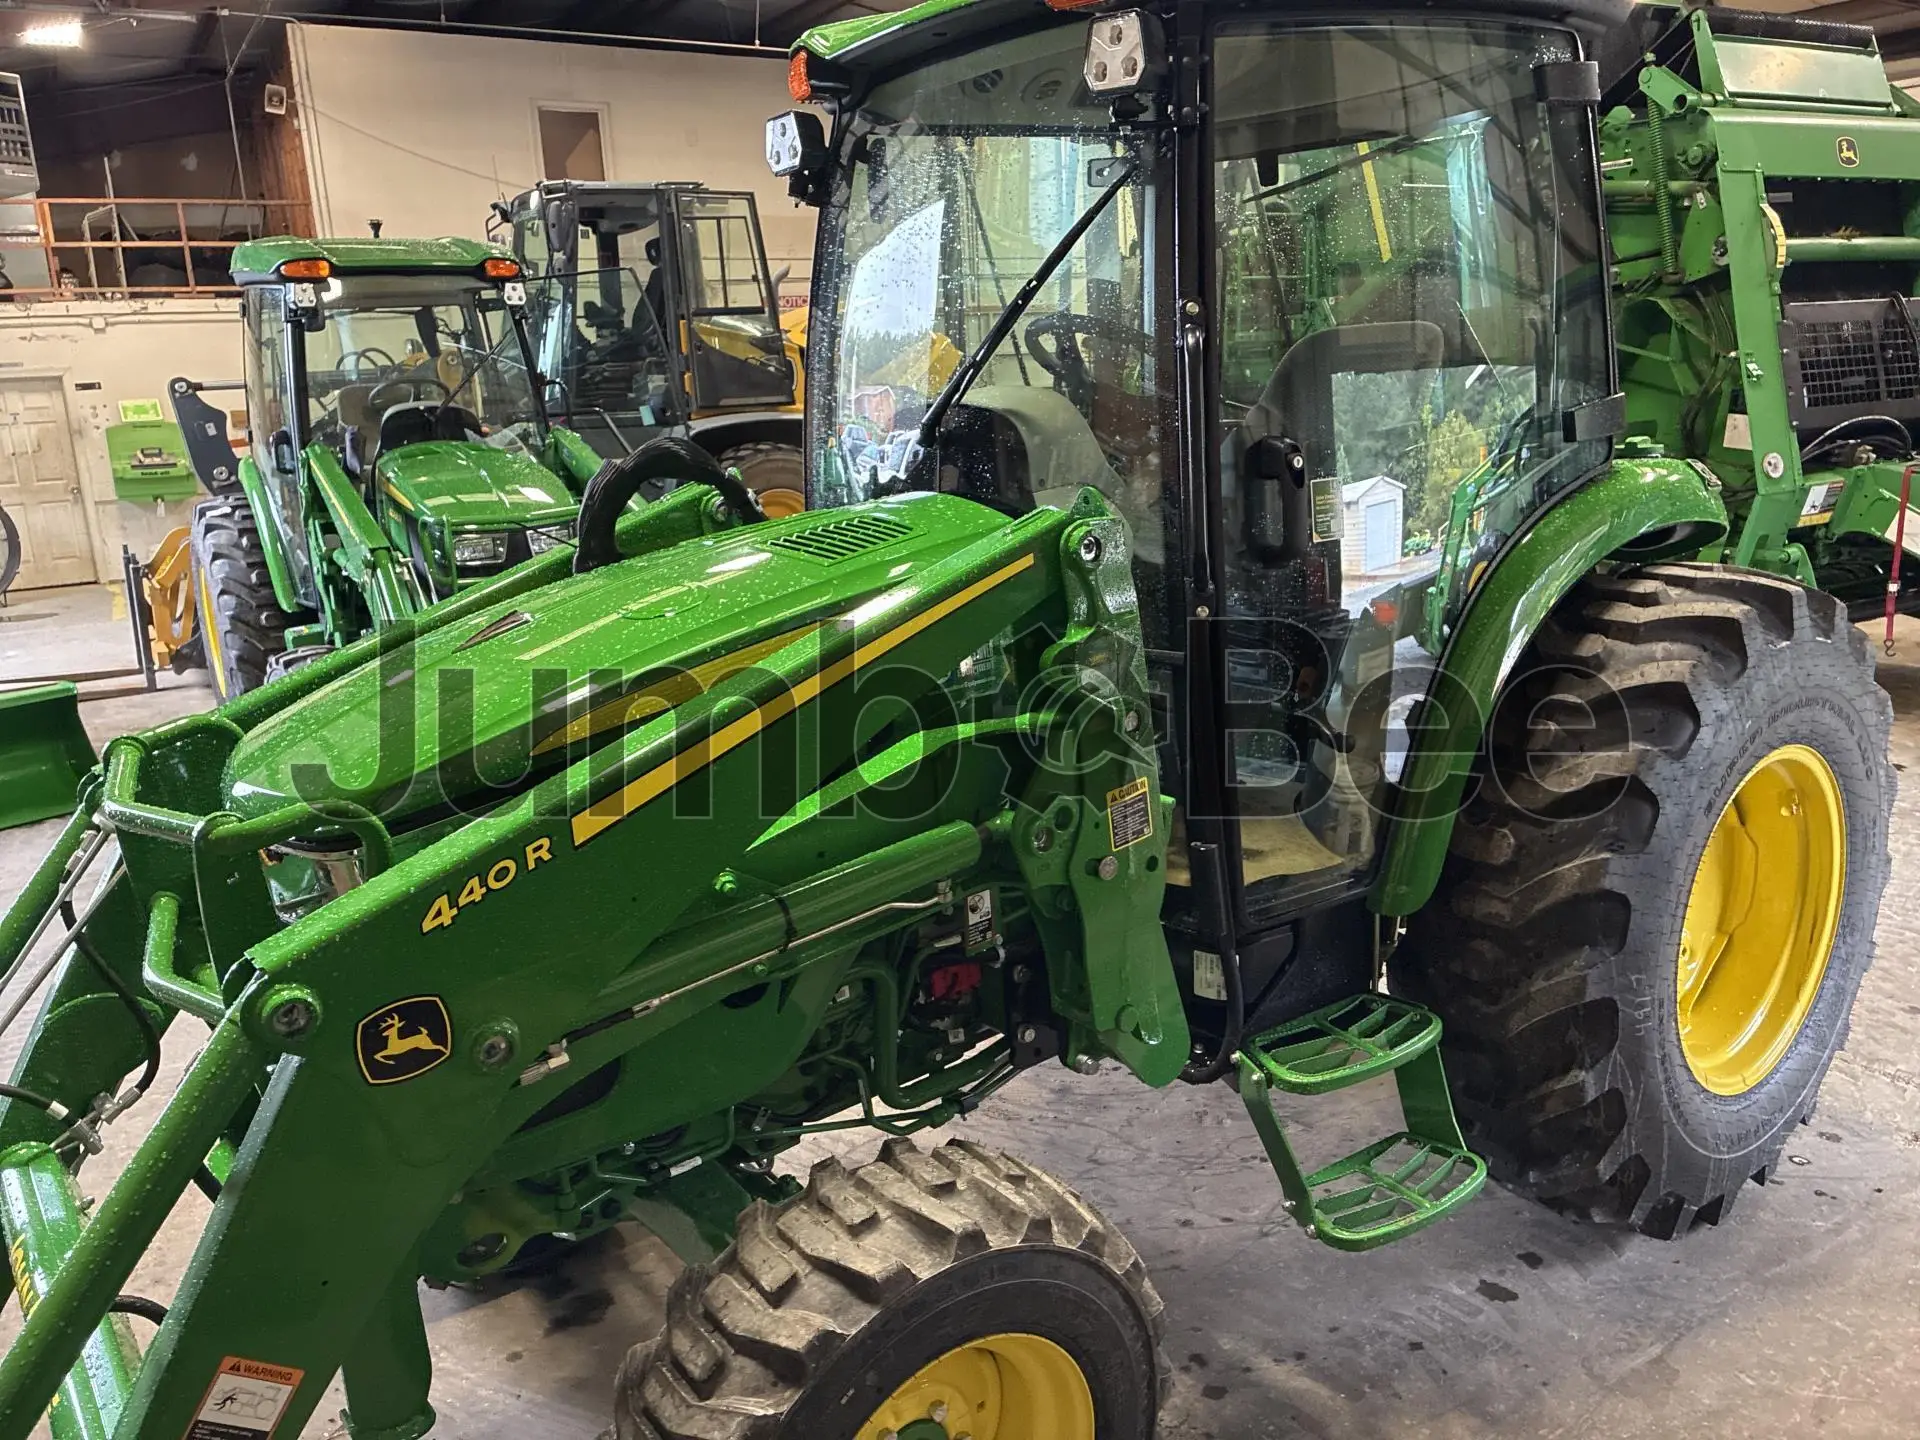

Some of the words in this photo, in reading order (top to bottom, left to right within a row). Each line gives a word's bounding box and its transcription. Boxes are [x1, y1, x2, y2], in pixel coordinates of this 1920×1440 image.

[779, 296, 807, 307] NOTIC
[1118, 780, 1146, 799] CAUTION
[243, 1362, 293, 1382] WARNING
